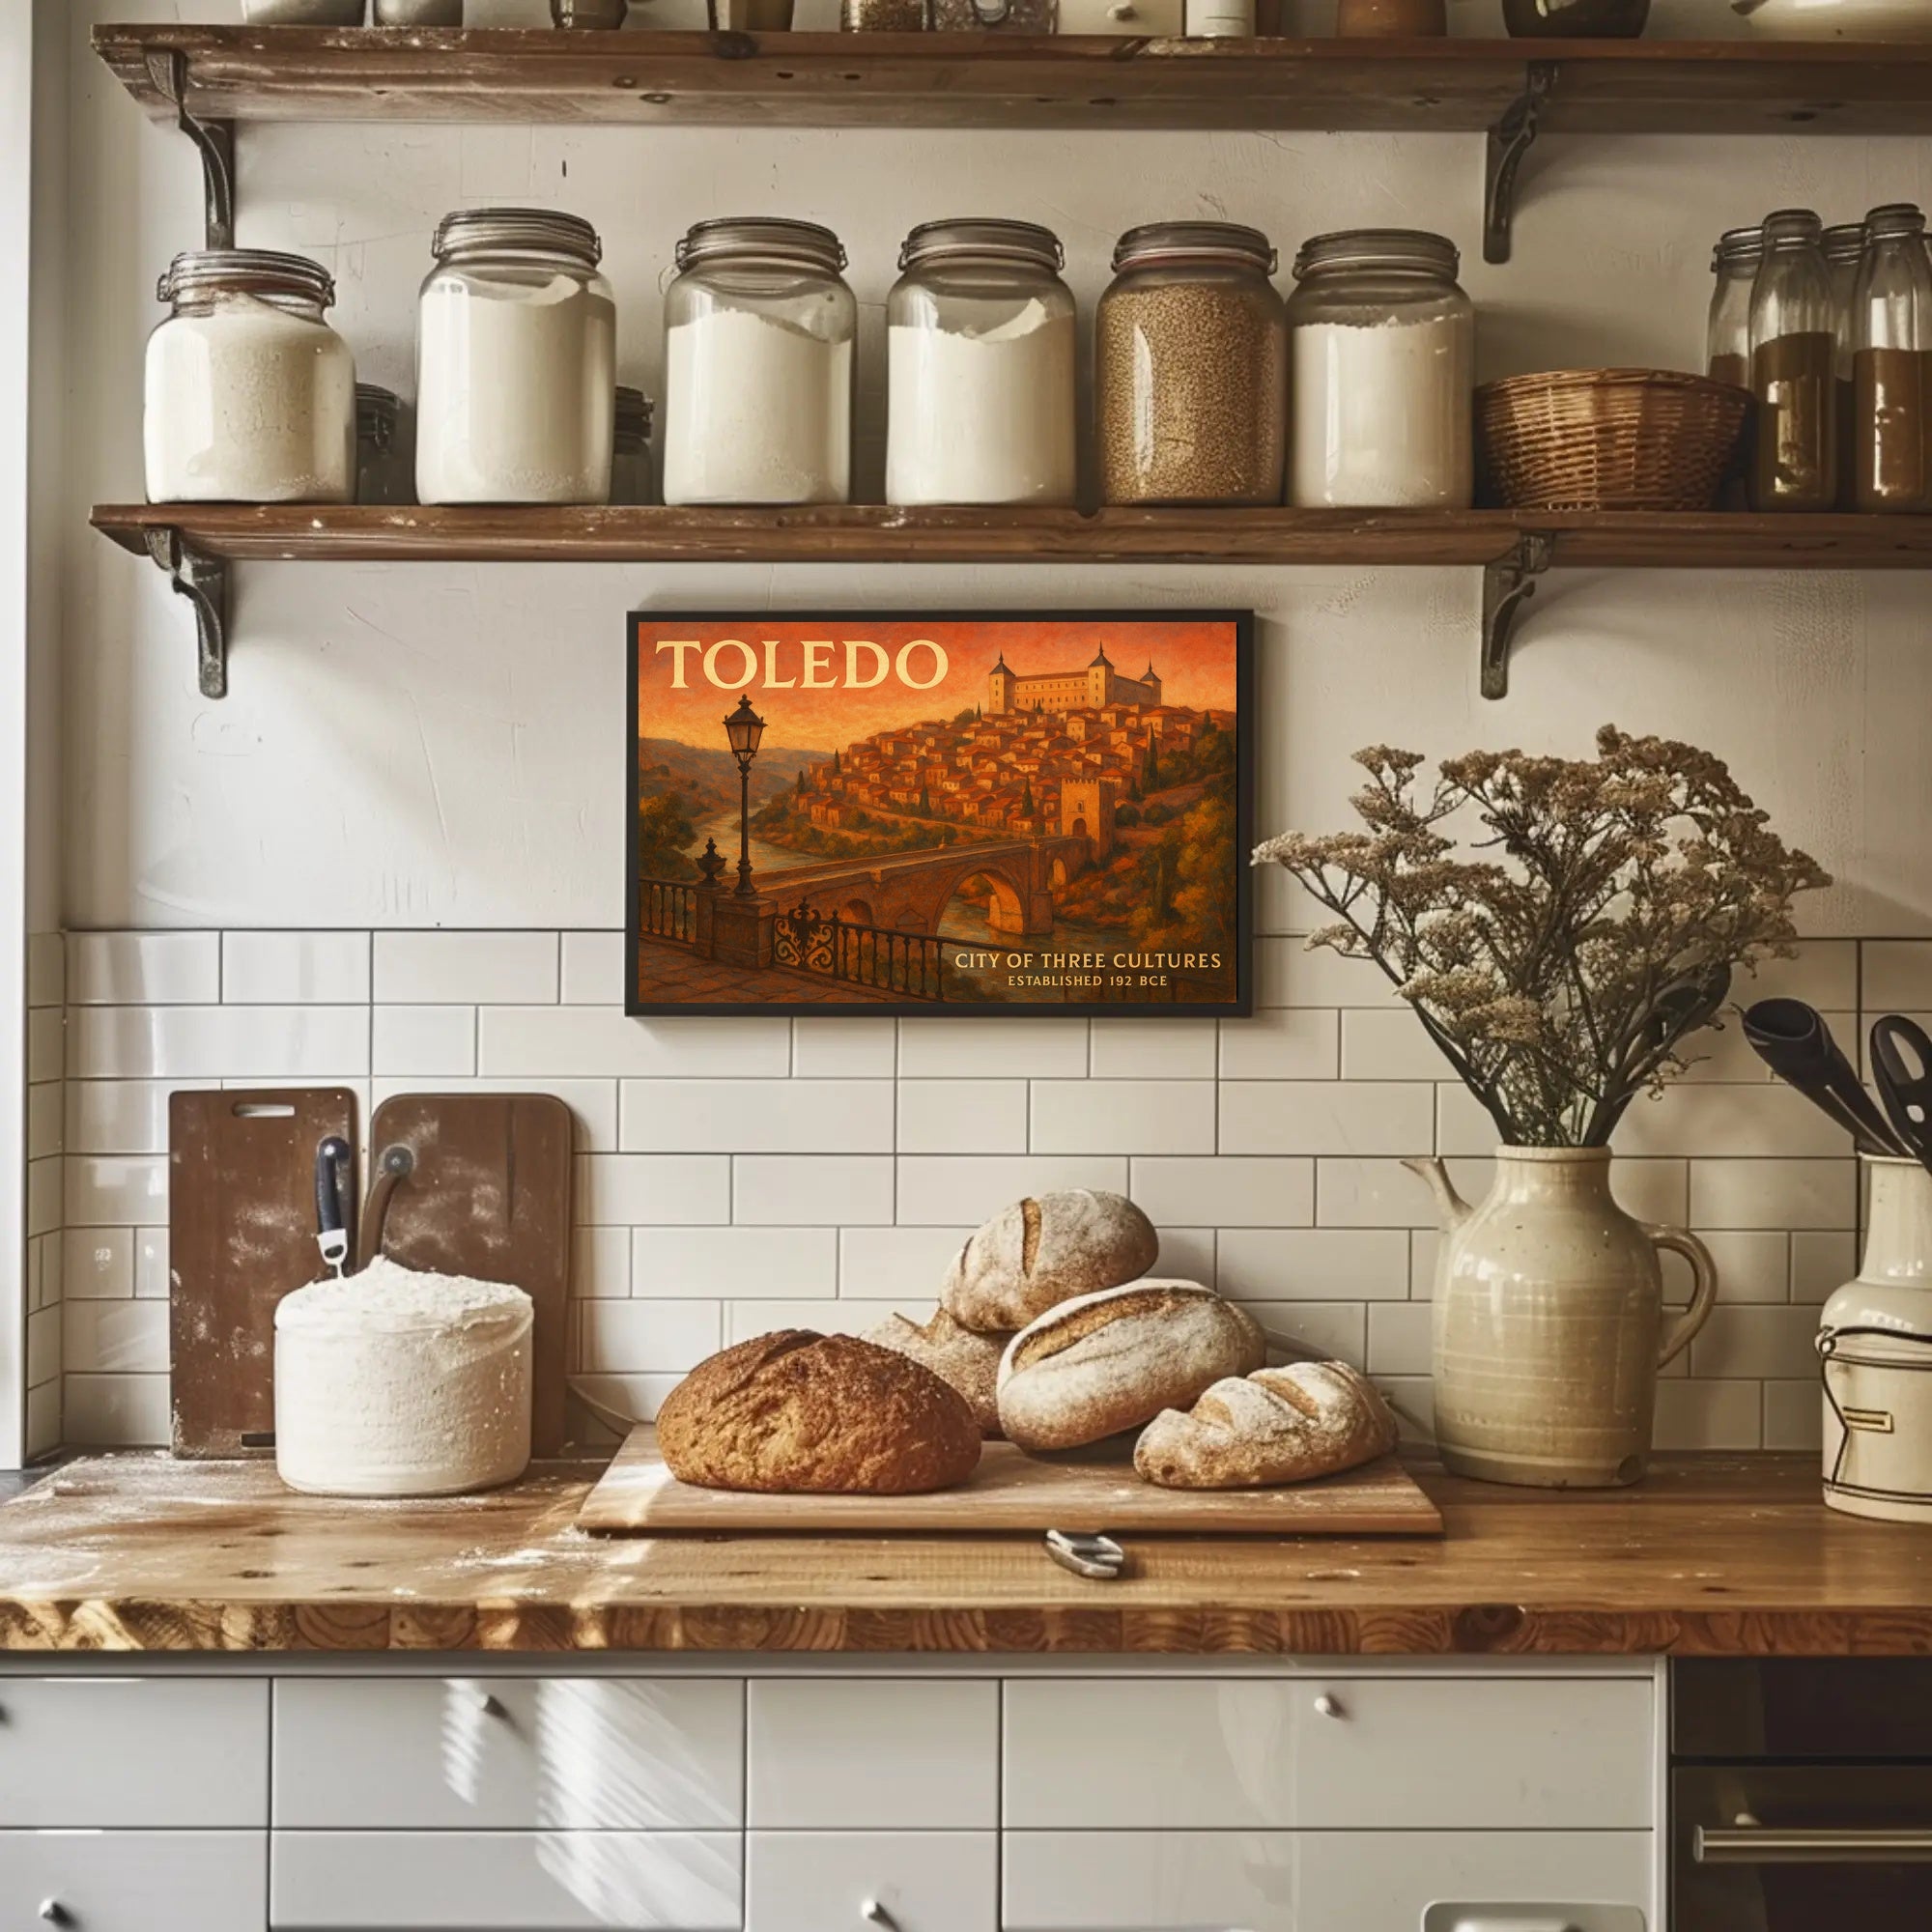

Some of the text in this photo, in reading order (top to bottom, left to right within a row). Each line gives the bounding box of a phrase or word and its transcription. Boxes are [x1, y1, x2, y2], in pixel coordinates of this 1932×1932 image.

[655, 639, 949, 690] TOLEDO
[954, 952, 1222, 969] CITY OF THREE CULTURES
[1008, 975, 1168, 986] ESTABLISHED 192 BCE
